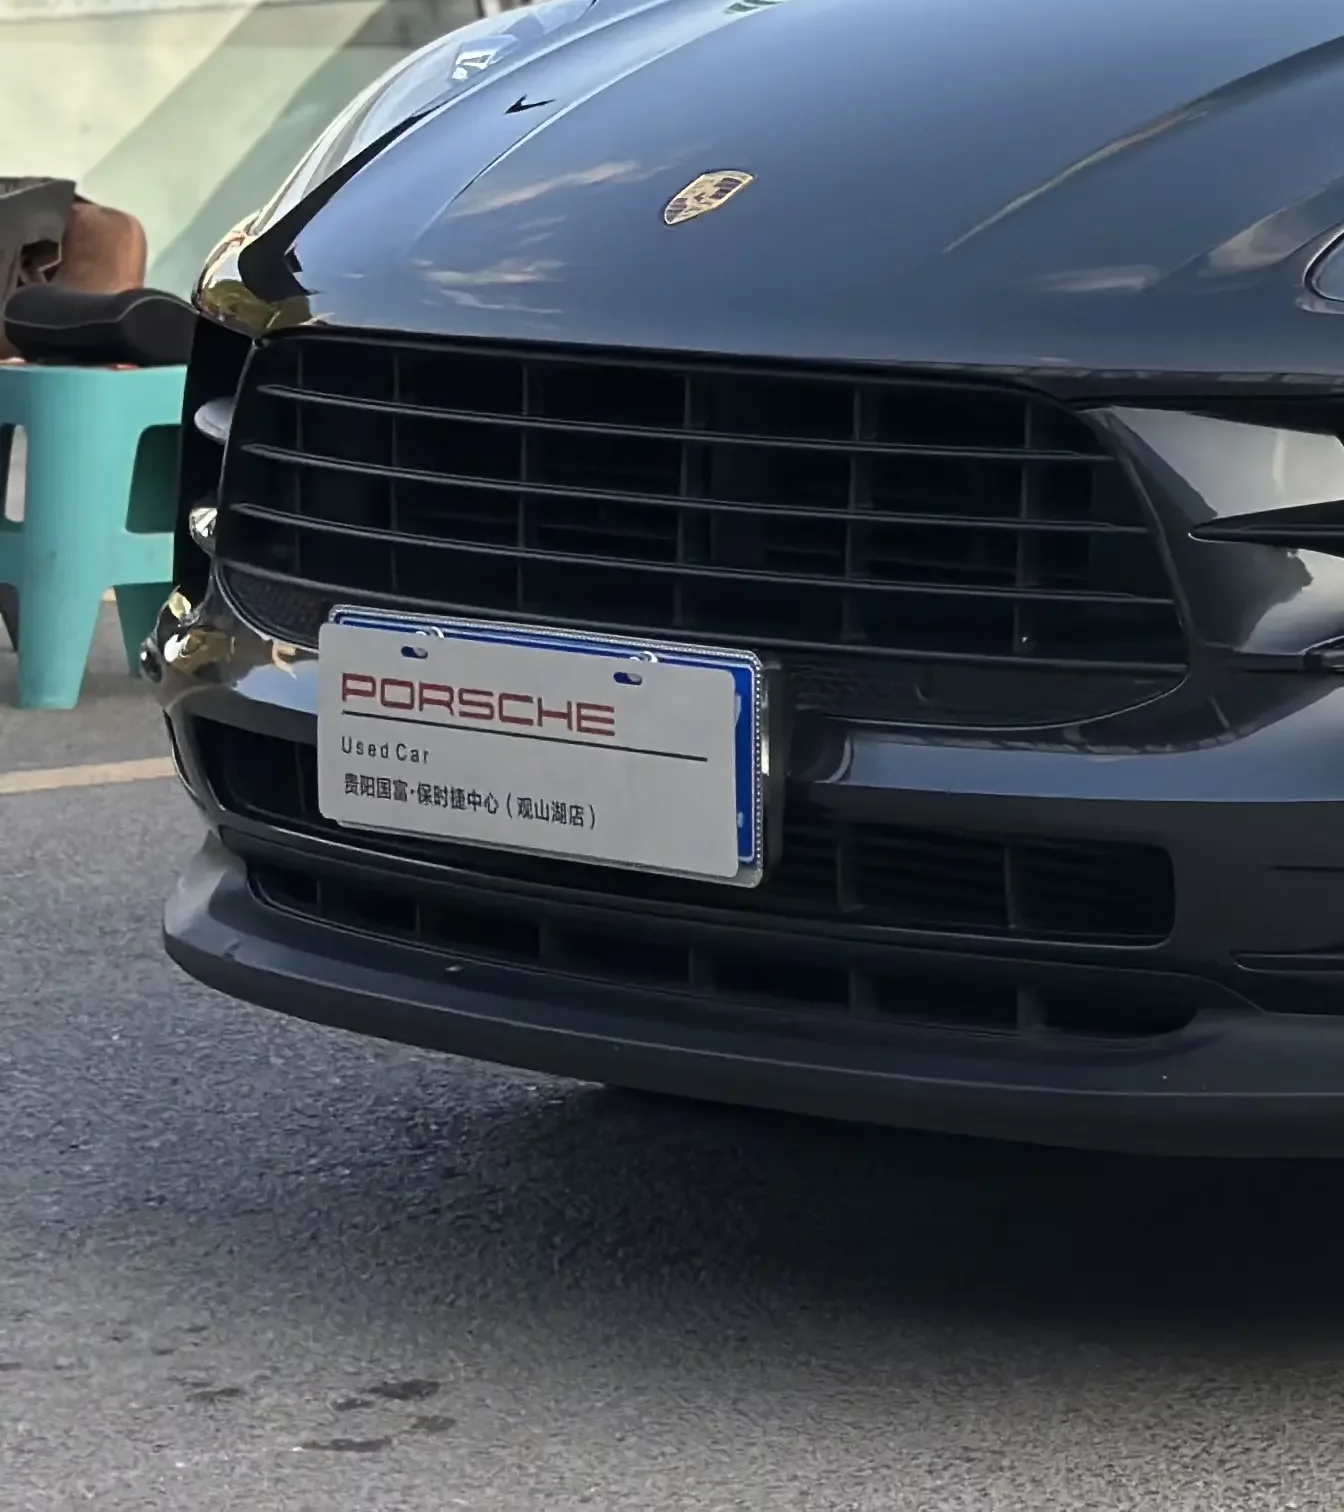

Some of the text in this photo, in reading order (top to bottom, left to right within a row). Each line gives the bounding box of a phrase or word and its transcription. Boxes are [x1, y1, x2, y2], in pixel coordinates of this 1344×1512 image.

[341, 672, 616, 737] PORSCHE
[341, 736, 431, 765] Used Car
